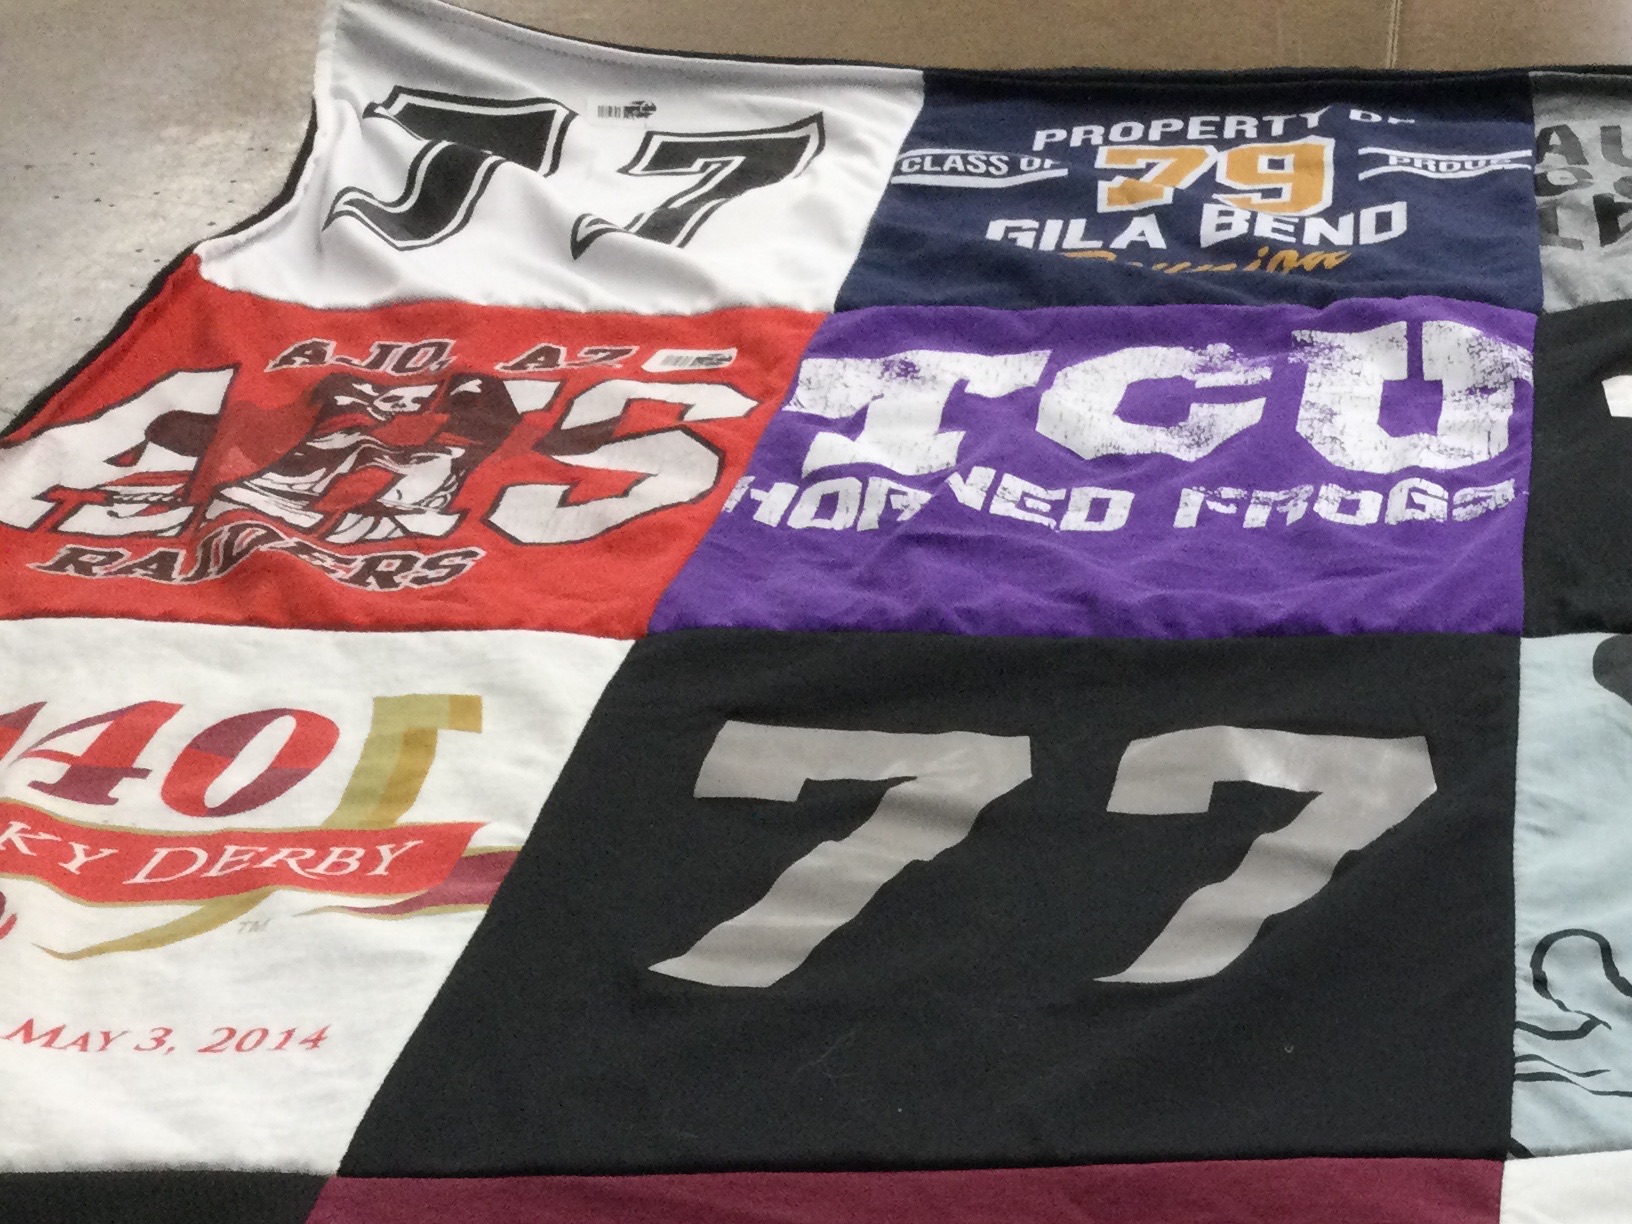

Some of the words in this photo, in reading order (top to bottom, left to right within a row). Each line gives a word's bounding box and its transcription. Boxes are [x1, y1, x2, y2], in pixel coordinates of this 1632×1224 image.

[1032, 106, 1331, 151] PROPERTY
[900, 154, 1010, 176] CLASS
[1094, 135, 1335, 216] 79
[986, 213, 1167, 251] GILA
[1200, 201, 1407, 248] BEND
[722, 465, 1136, 532] HORNED
[122, 839, 425, 885] DERBY
[647, 720, 1438, 989] 77
[1, 1017, 128, 1054] MAY
[134, 1026, 177, 1056] 3,
[197, 1023, 332, 1055] 2014
